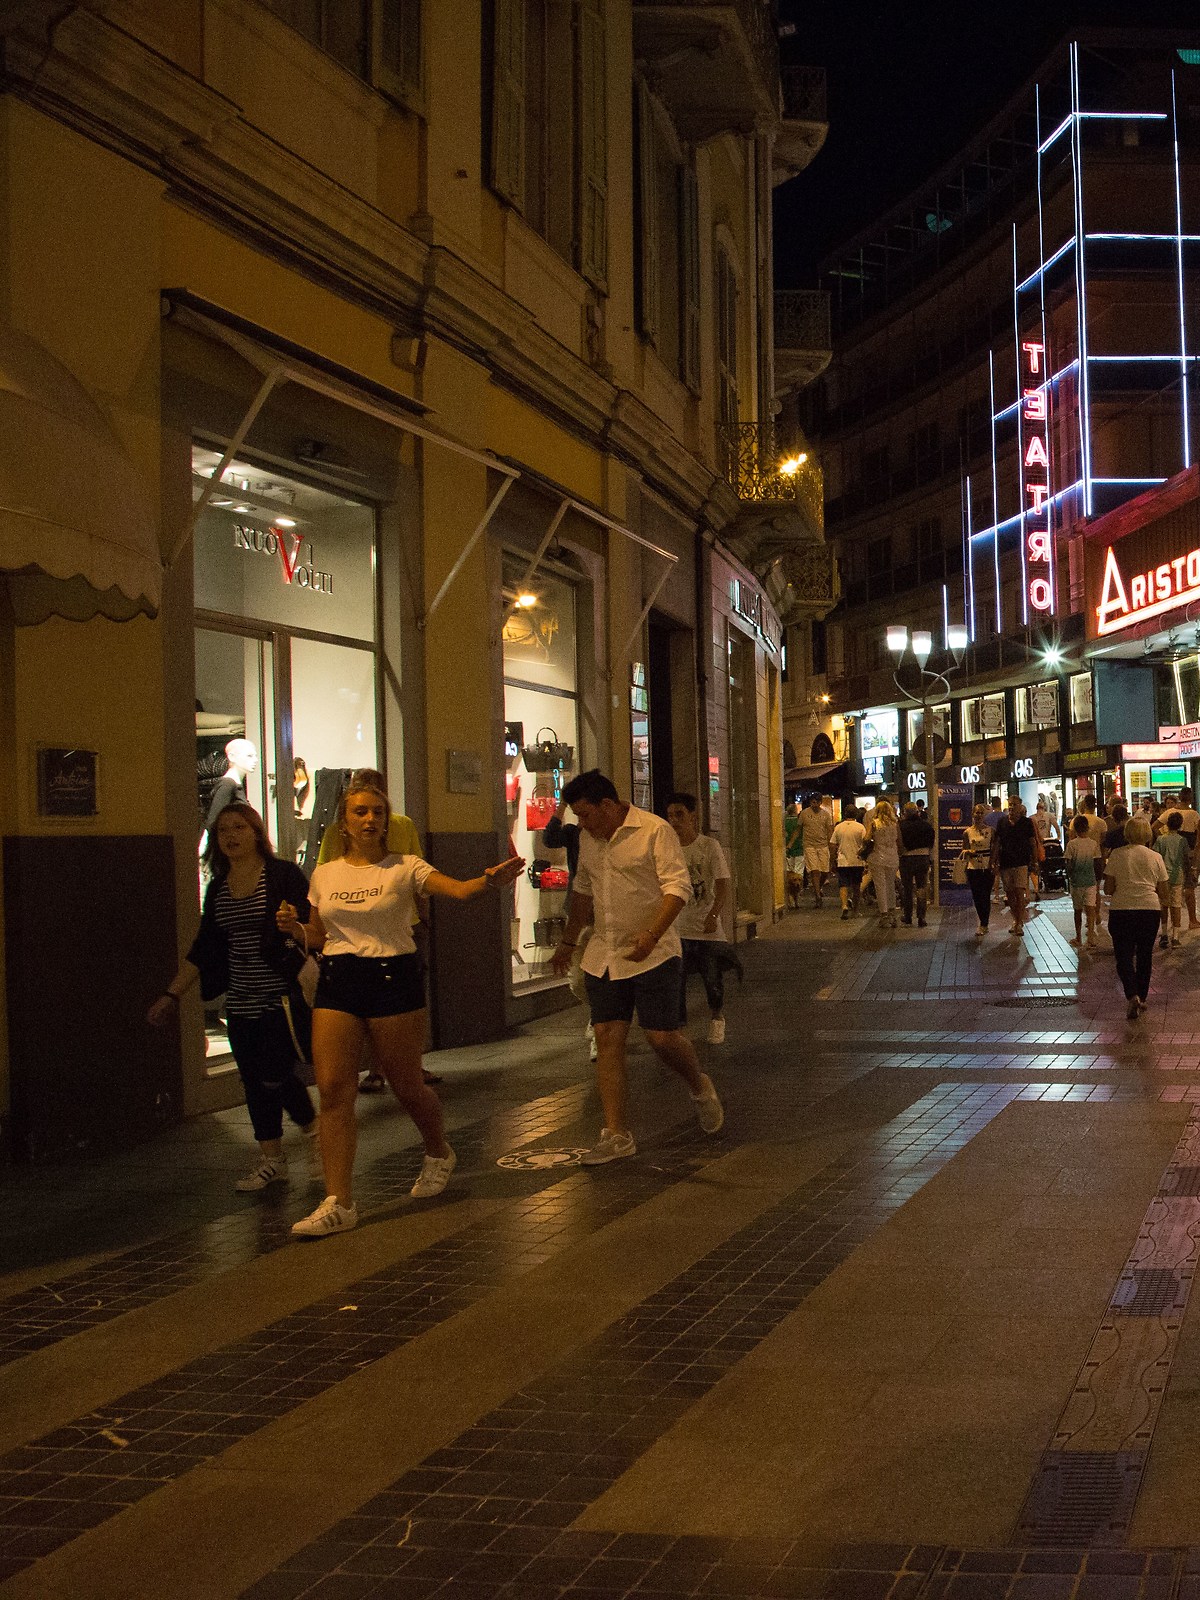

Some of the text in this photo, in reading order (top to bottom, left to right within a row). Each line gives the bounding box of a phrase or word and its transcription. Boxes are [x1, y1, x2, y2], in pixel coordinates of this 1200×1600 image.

[908, 772, 926, 789] OVS
[961, 765, 980, 784] OVS
[329, 884, 384, 900] normal
